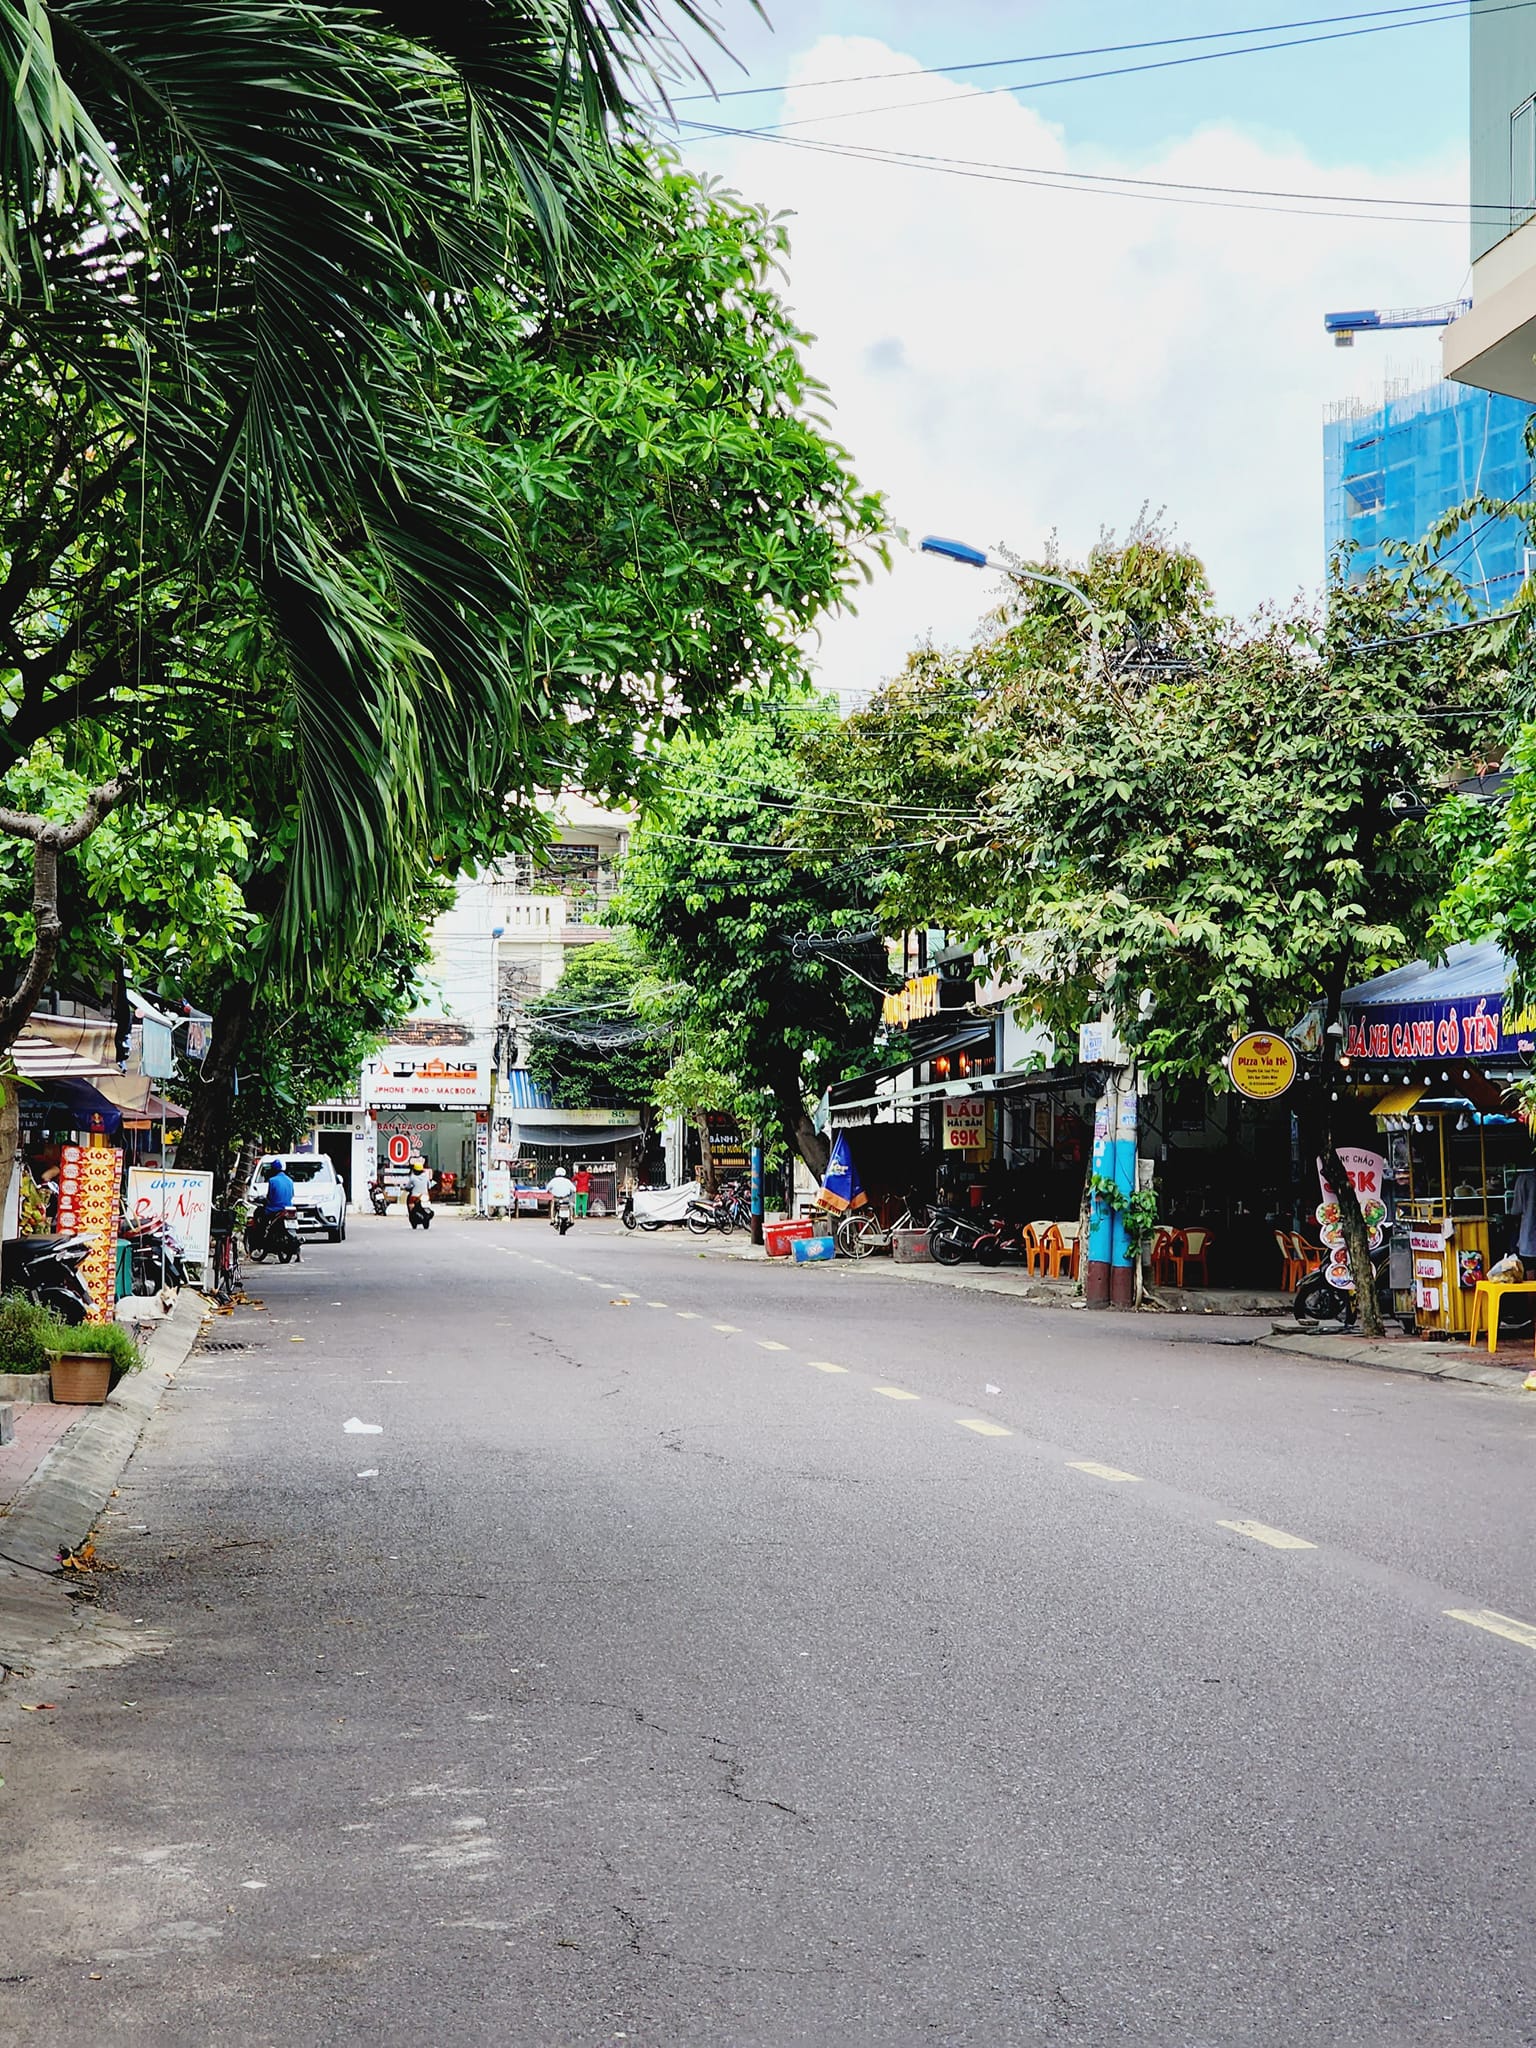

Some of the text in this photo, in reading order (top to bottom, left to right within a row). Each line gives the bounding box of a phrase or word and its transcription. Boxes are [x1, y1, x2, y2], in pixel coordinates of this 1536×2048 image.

[1392, 1020, 1434, 1057] CANH
[1436, 1007, 1459, 1055] CÔ
[1238, 1056, 1258, 1066] Pizza
[436, 1087, 477, 1095] MACBOOK
[612, 1110, 626, 1118] 85
[950, 1130, 980, 1146] 69K
